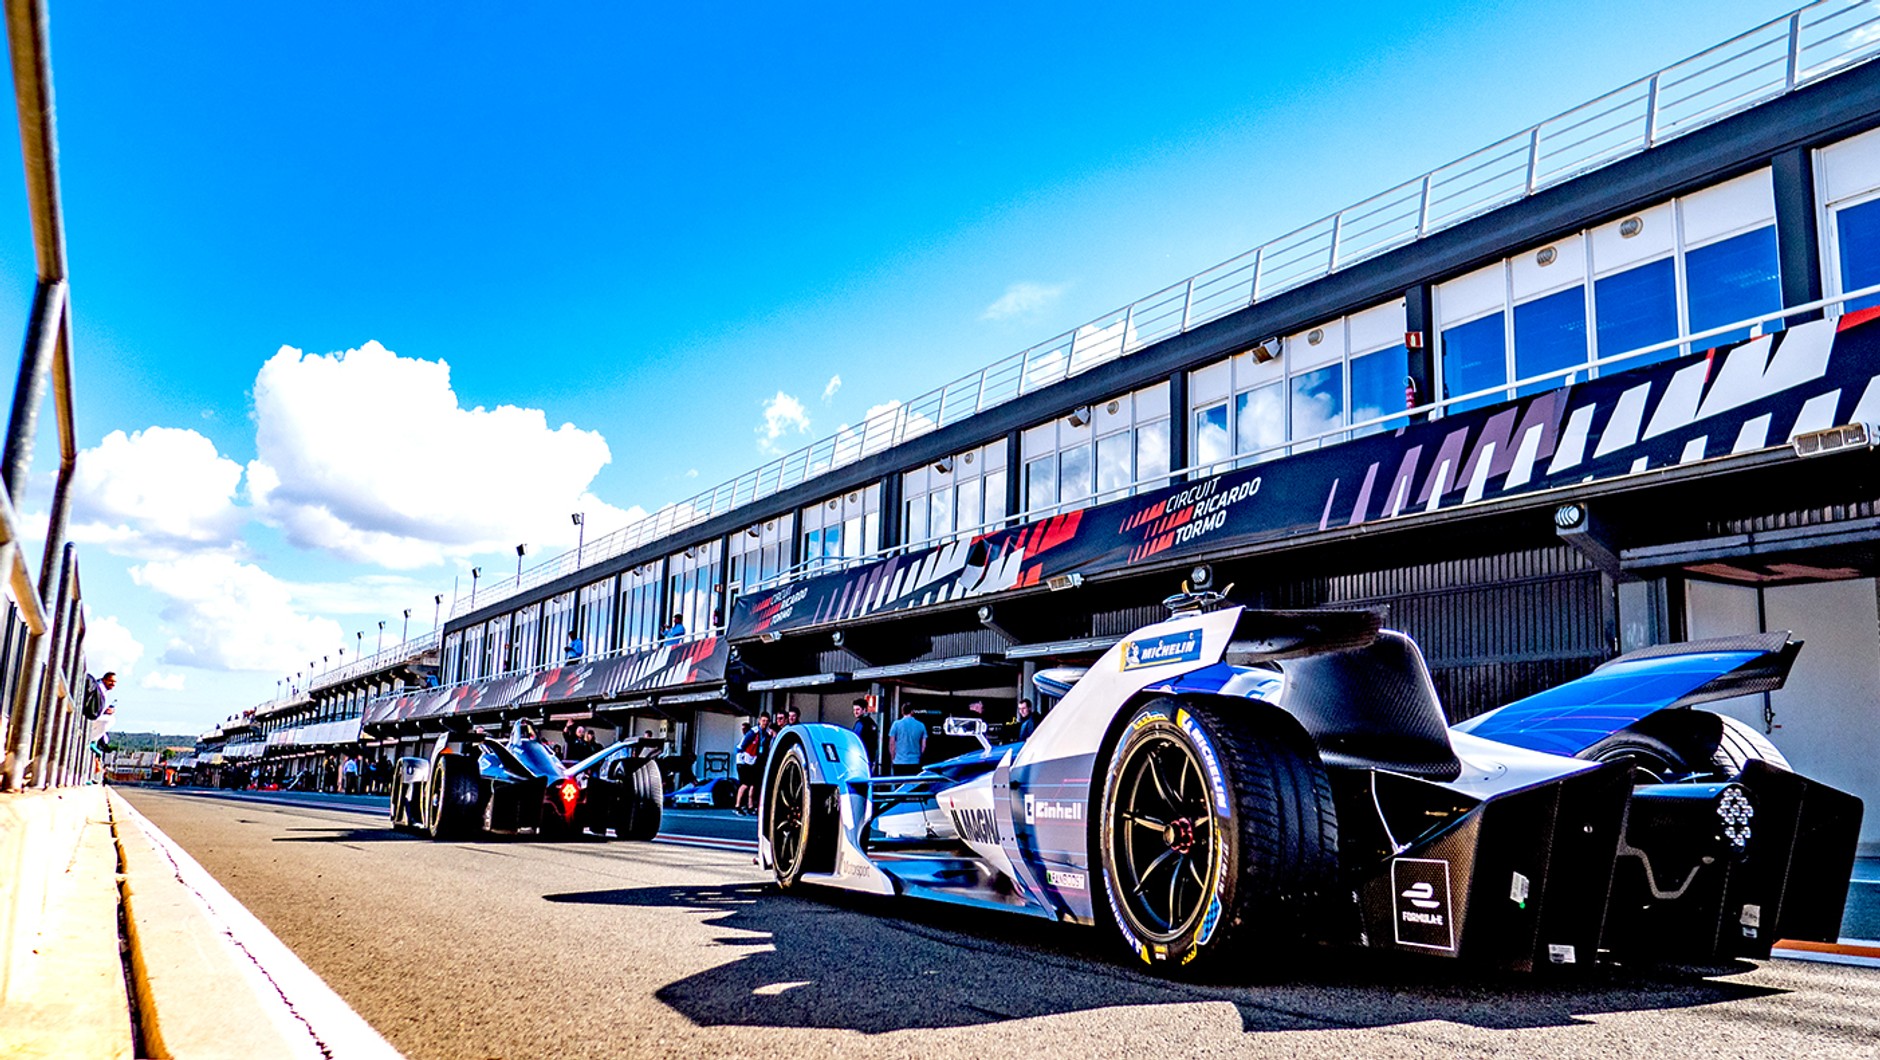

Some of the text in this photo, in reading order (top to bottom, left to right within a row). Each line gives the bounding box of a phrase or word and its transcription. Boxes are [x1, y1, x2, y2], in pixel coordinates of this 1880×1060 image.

[1165, 476, 1222, 513] CIRCUIT
[1193, 476, 1262, 520] RICARDO
[1175, 509, 1227, 545] TORMO
[1141, 638, 1196, 660] MICHELIN
[1190, 727, 1227, 808] MICHELIN
[1036, 801, 1081, 820] Einhell
